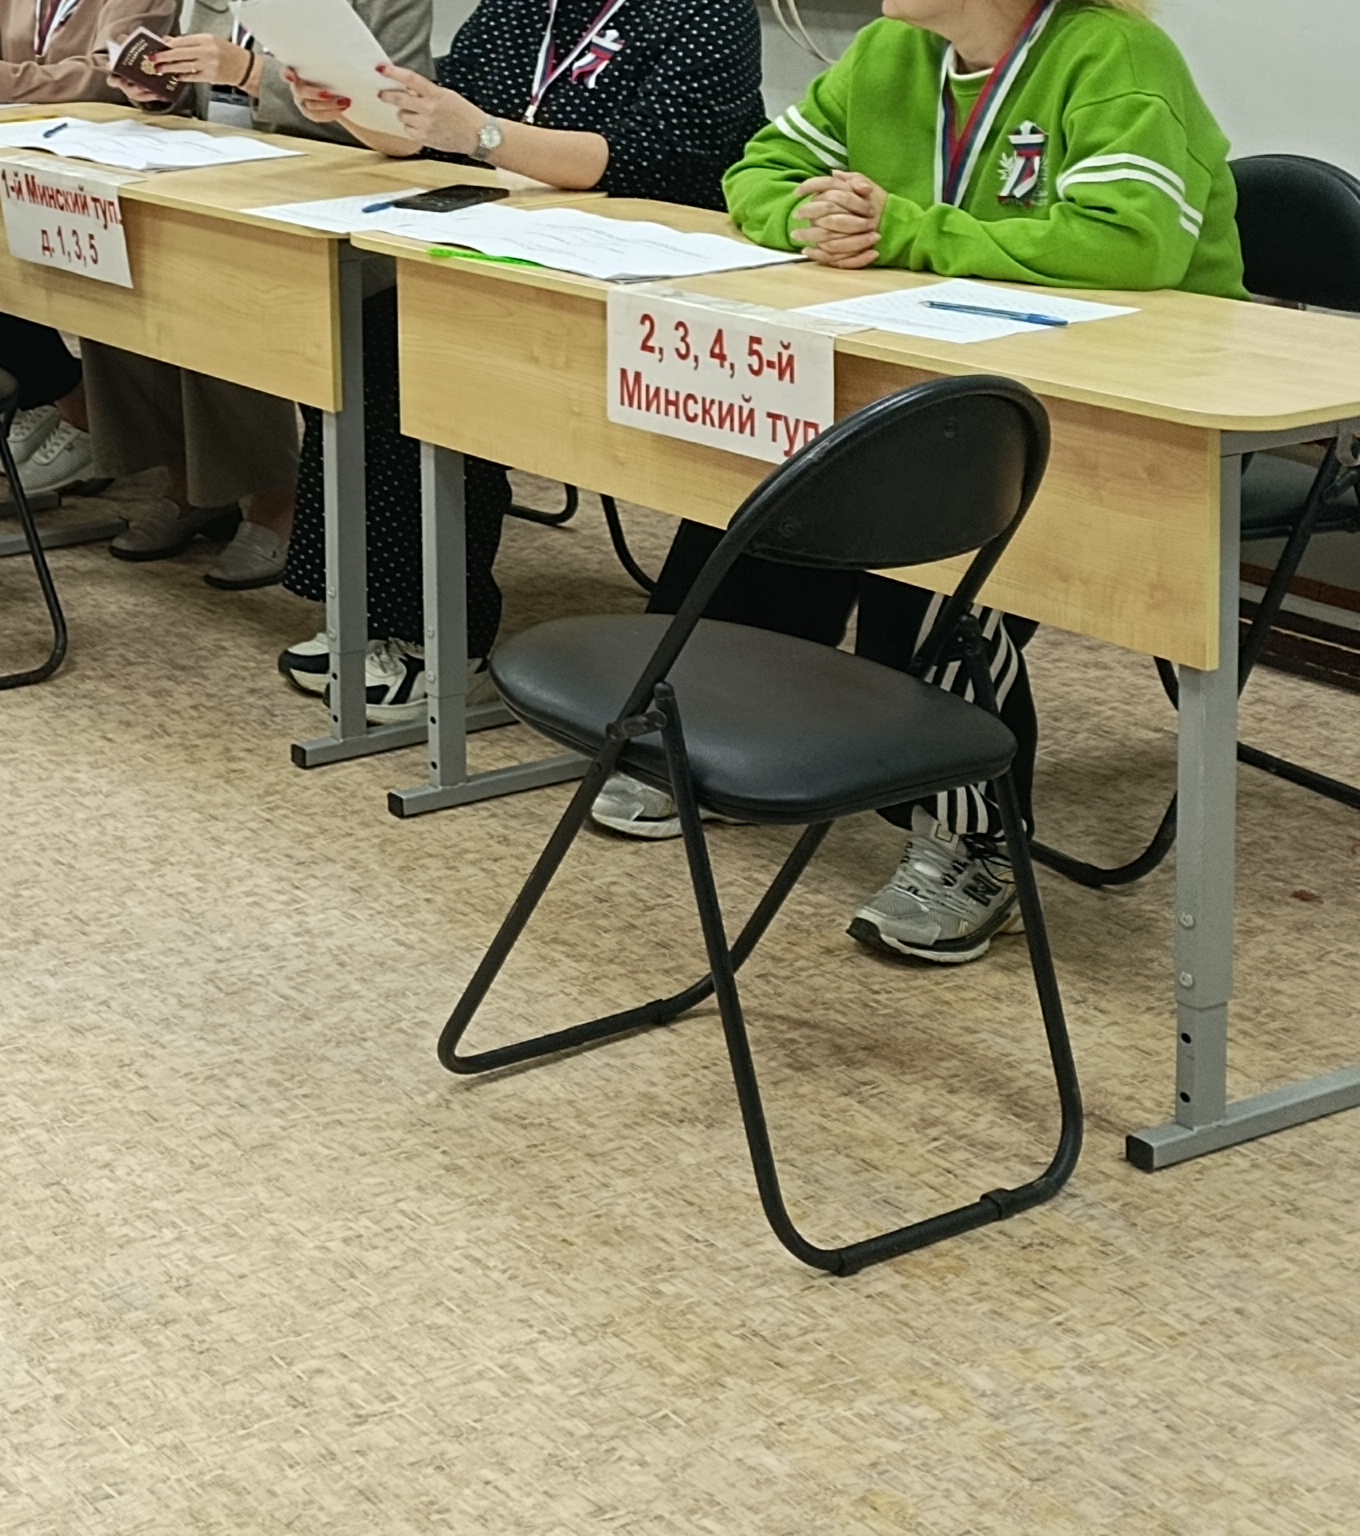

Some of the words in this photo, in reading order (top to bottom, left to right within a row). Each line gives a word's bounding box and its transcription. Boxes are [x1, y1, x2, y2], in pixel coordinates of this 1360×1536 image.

[1, 169, 24, 202] 1-й
[24, 173, 90, 217] Минский
[91, 195, 123, 230] туп.
[88, 233, 99, 265] 5
[640, 313, 664, 363] 2,
[674, 320, 700, 371] 3,
[709, 328, 736, 379] 4,
[747, 335, 796, 384] 5-й
[619, 367, 756, 438] Минский
